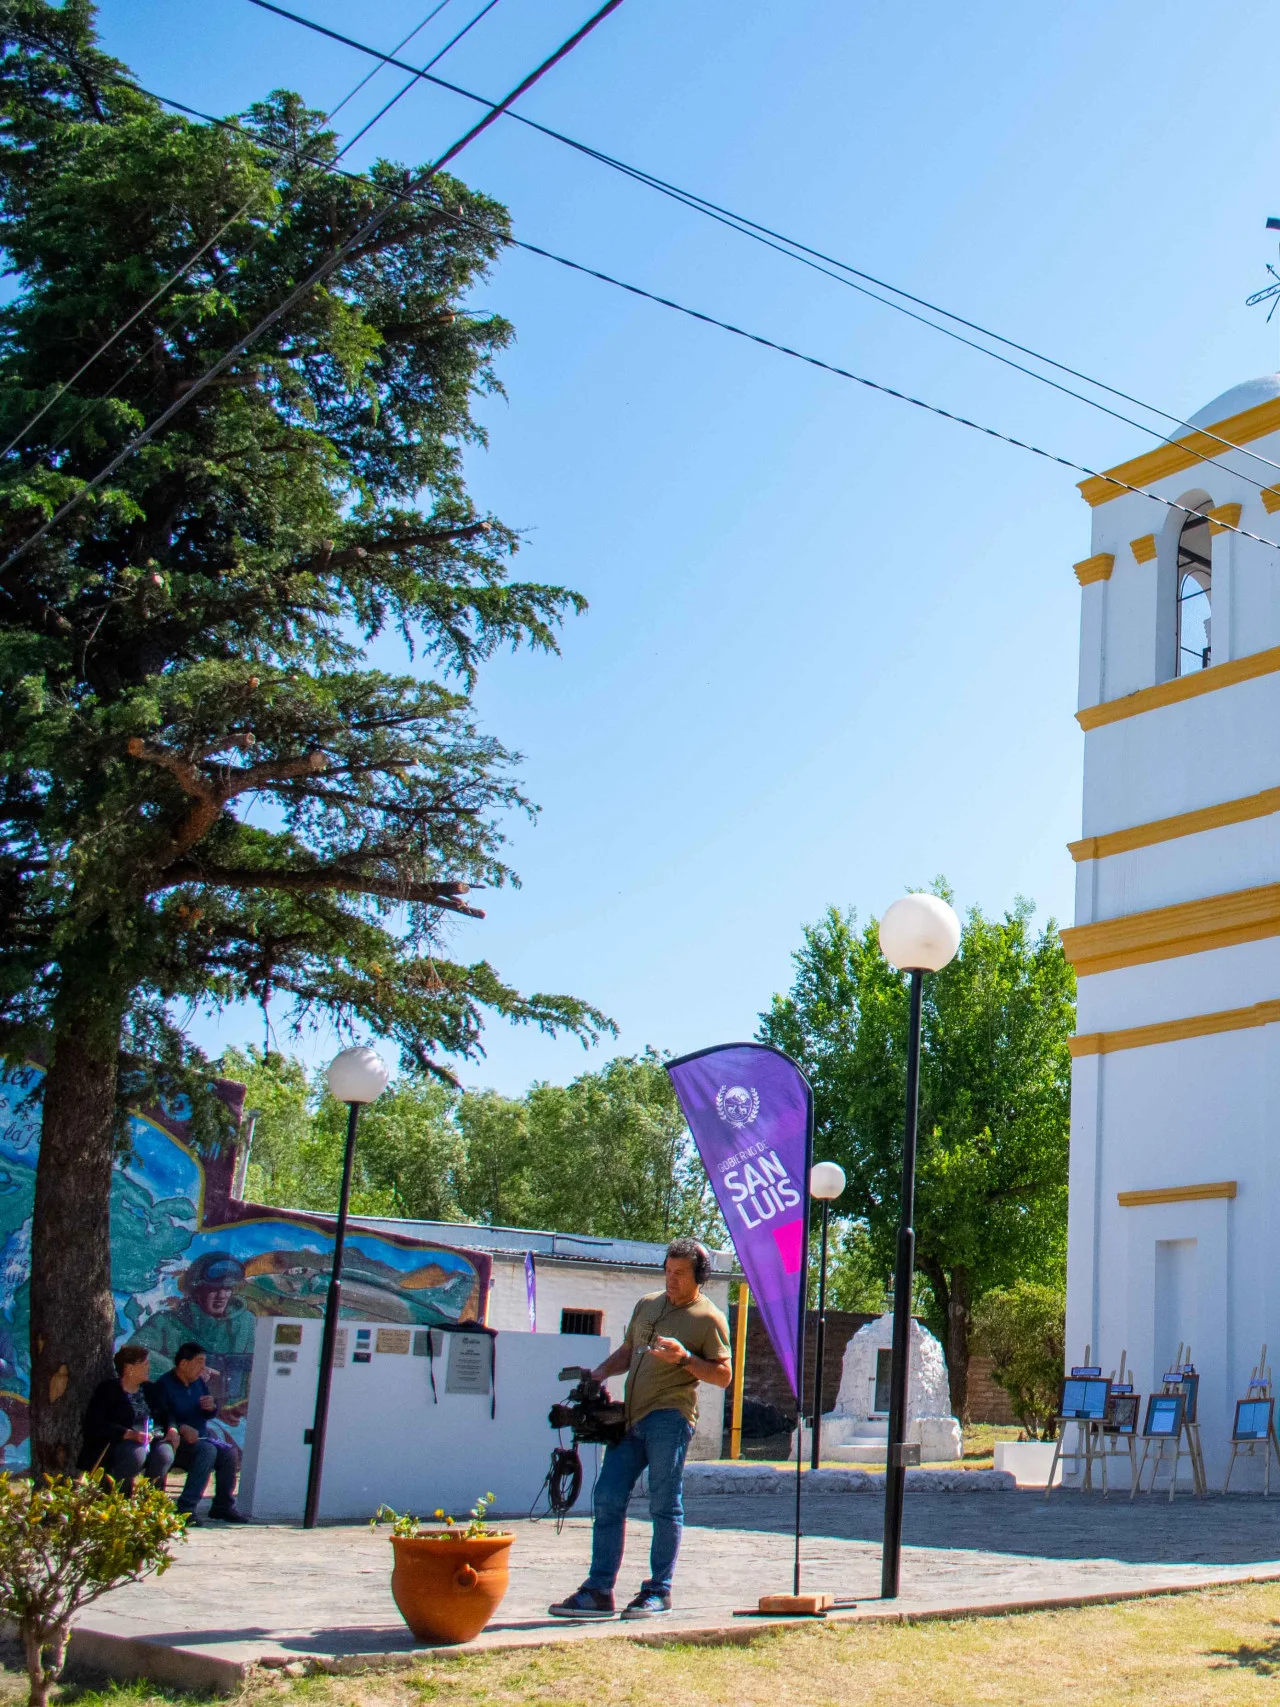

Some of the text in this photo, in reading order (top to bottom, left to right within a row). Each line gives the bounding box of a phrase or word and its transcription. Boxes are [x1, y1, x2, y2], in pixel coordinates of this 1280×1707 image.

[717, 1146, 758, 1173] GOBIERNO
[723, 1150, 788, 1202] SAN
[736, 1178, 801, 1229] LUIS
